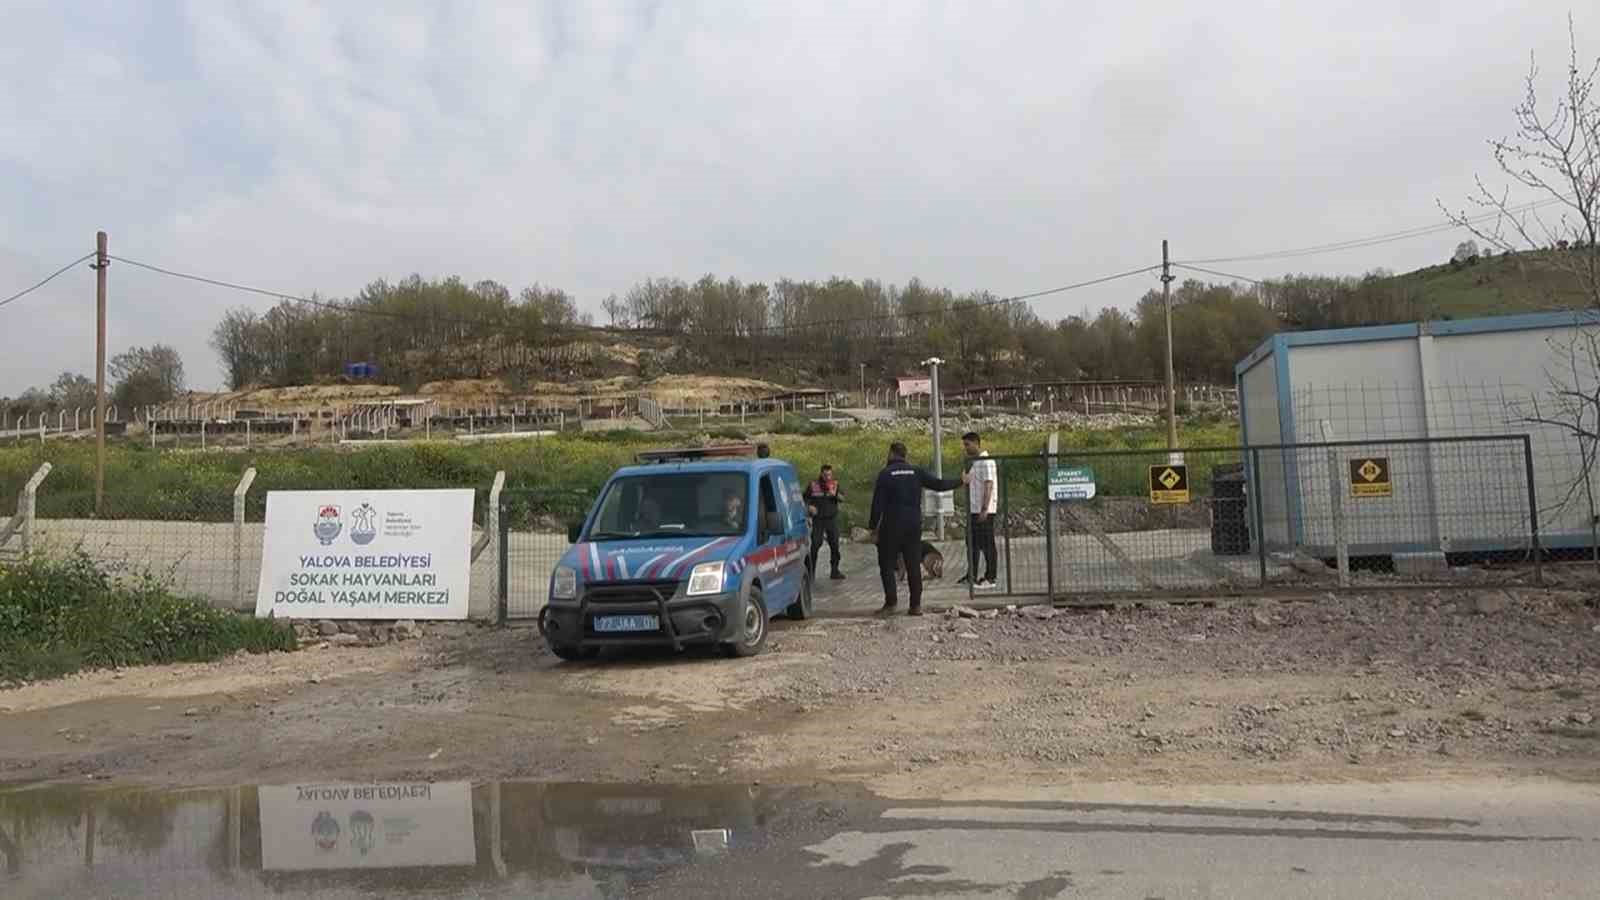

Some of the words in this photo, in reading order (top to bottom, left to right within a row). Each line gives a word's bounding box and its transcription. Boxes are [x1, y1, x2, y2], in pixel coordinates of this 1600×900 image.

[300, 555, 351, 568] YALOVA
[355, 552, 431, 568] BELEDİYESİ
[290, 573, 339, 586] SOKAK
[342, 573, 436, 587] HAYVANLARI
[275, 588, 326, 604] DOĞAL
[331, 591, 381, 607] YAŞAM
[383, 589, 450, 605] MERKEZİ
